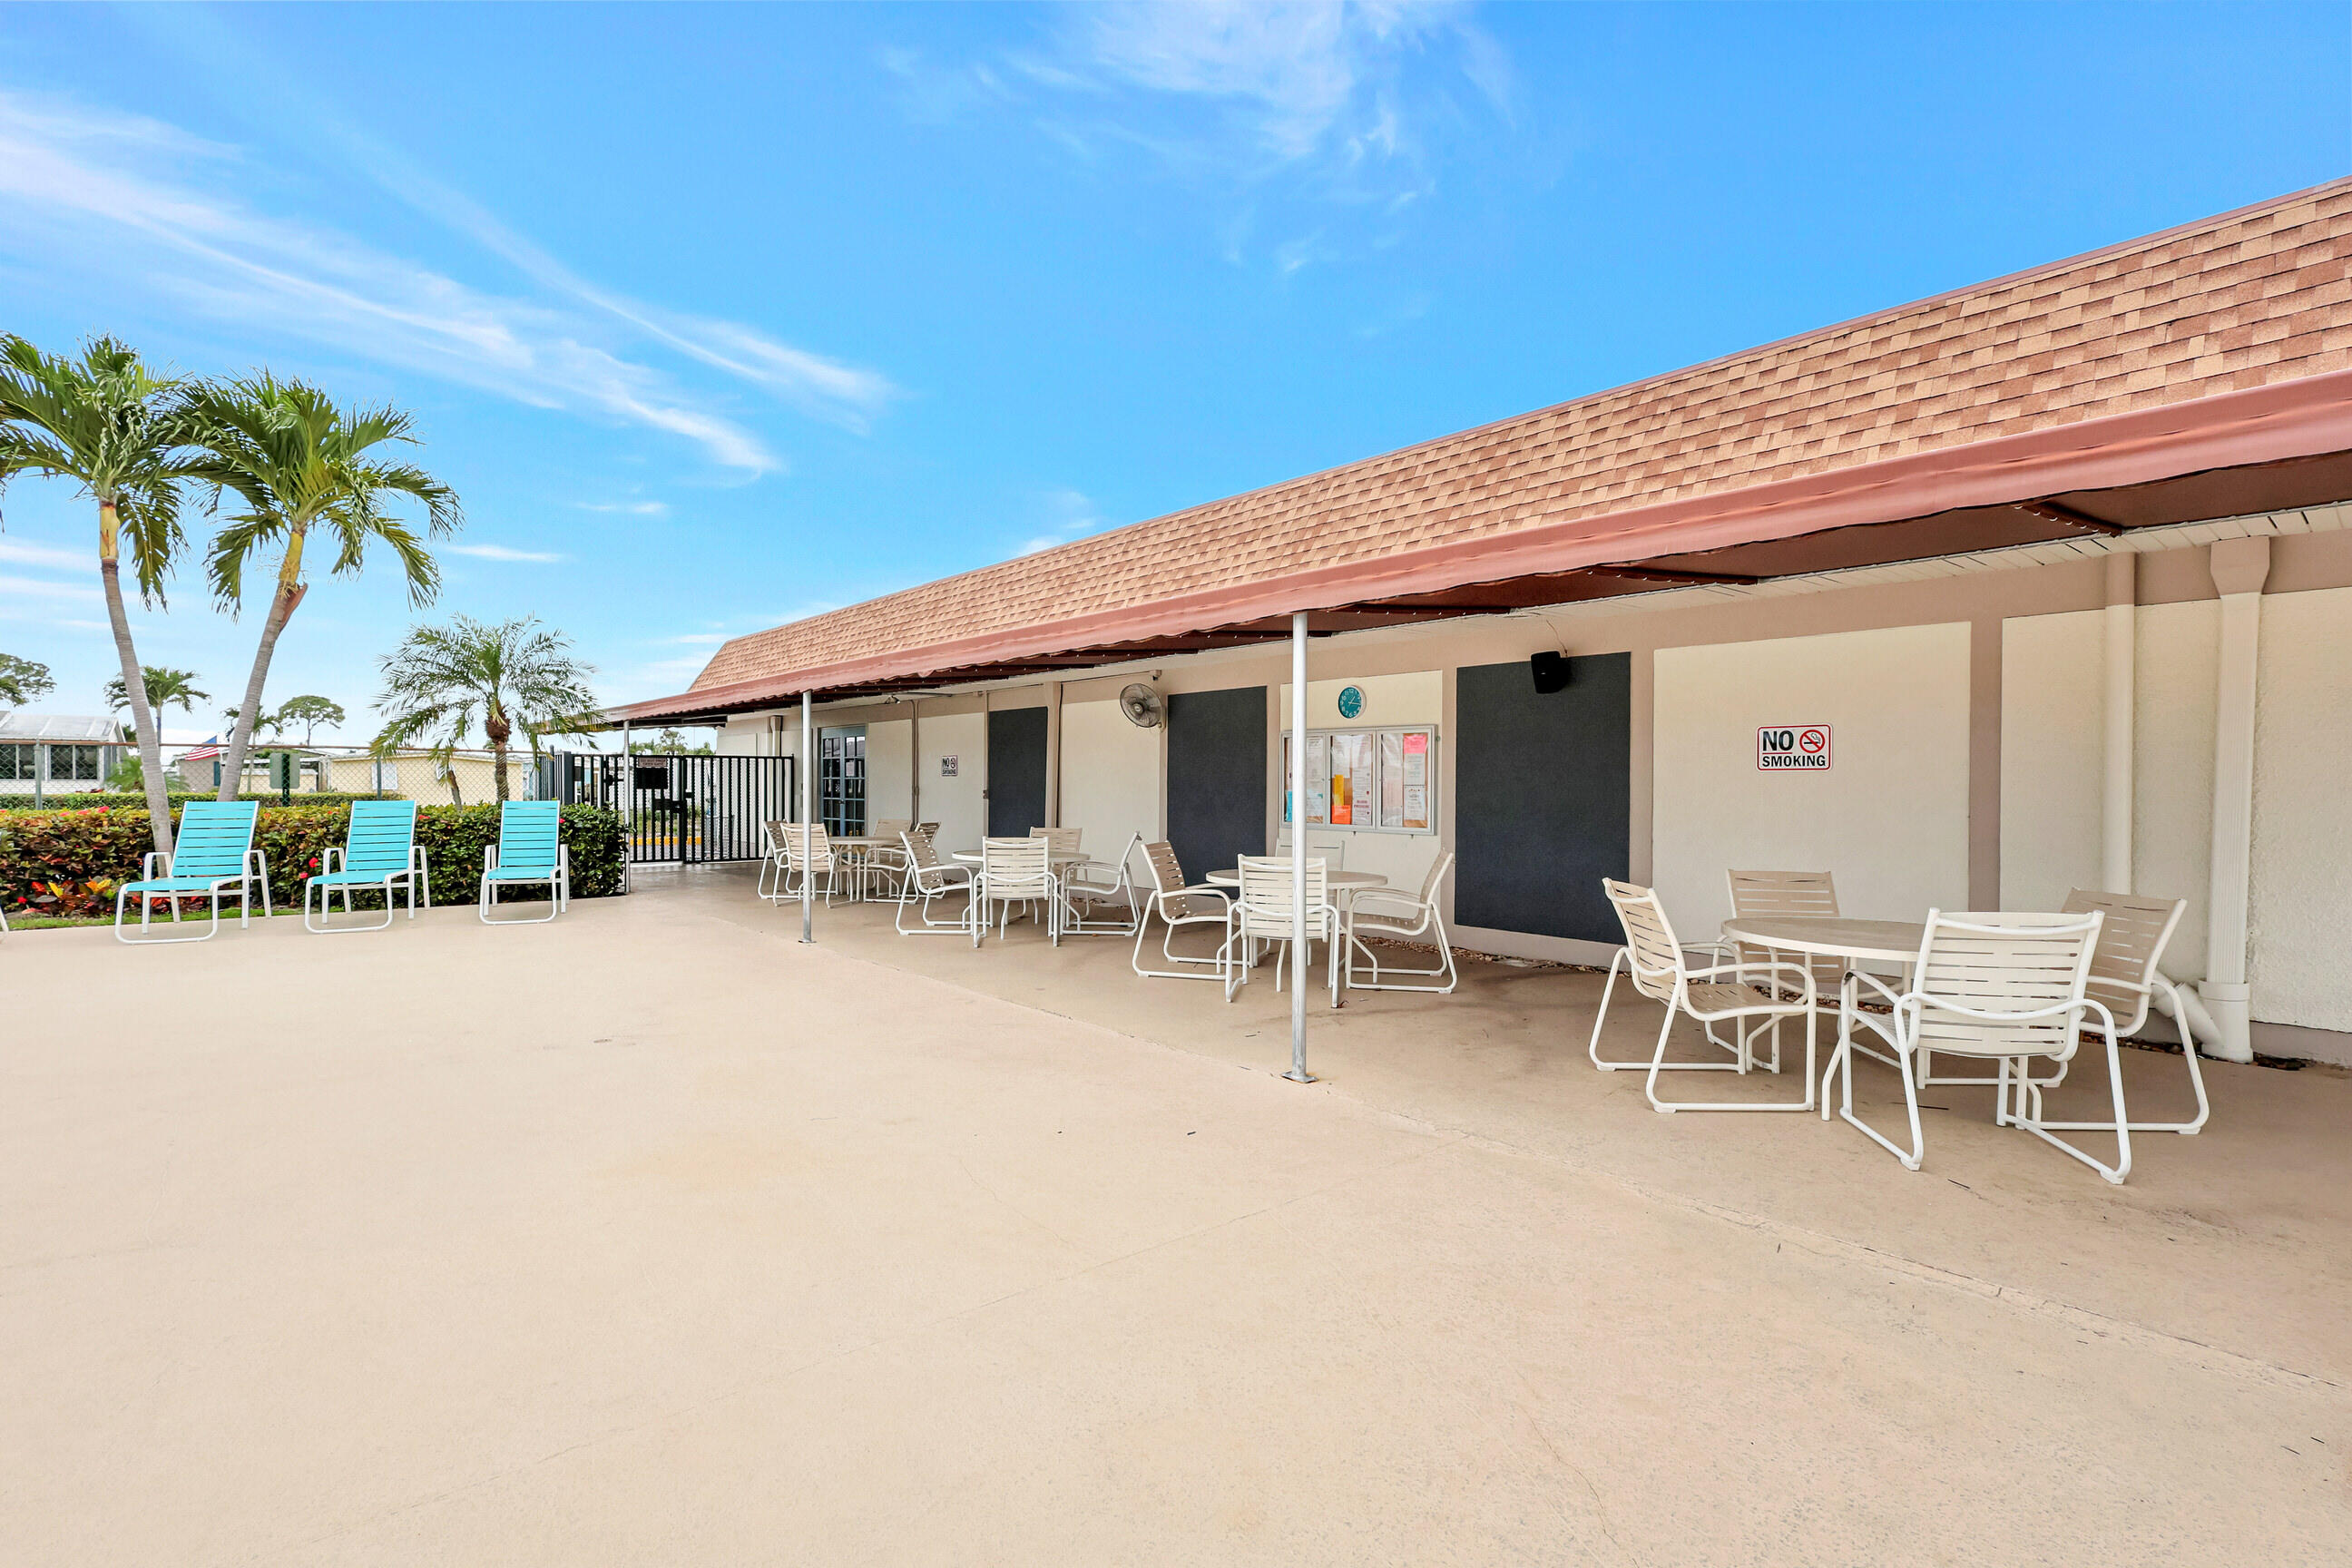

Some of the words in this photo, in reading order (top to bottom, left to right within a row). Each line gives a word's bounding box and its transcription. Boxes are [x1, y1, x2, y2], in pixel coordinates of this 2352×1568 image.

[1763, 730, 1794, 751] NO
[942, 758, 949, 768] NO
[1762, 755, 1826, 767] SMOKING
